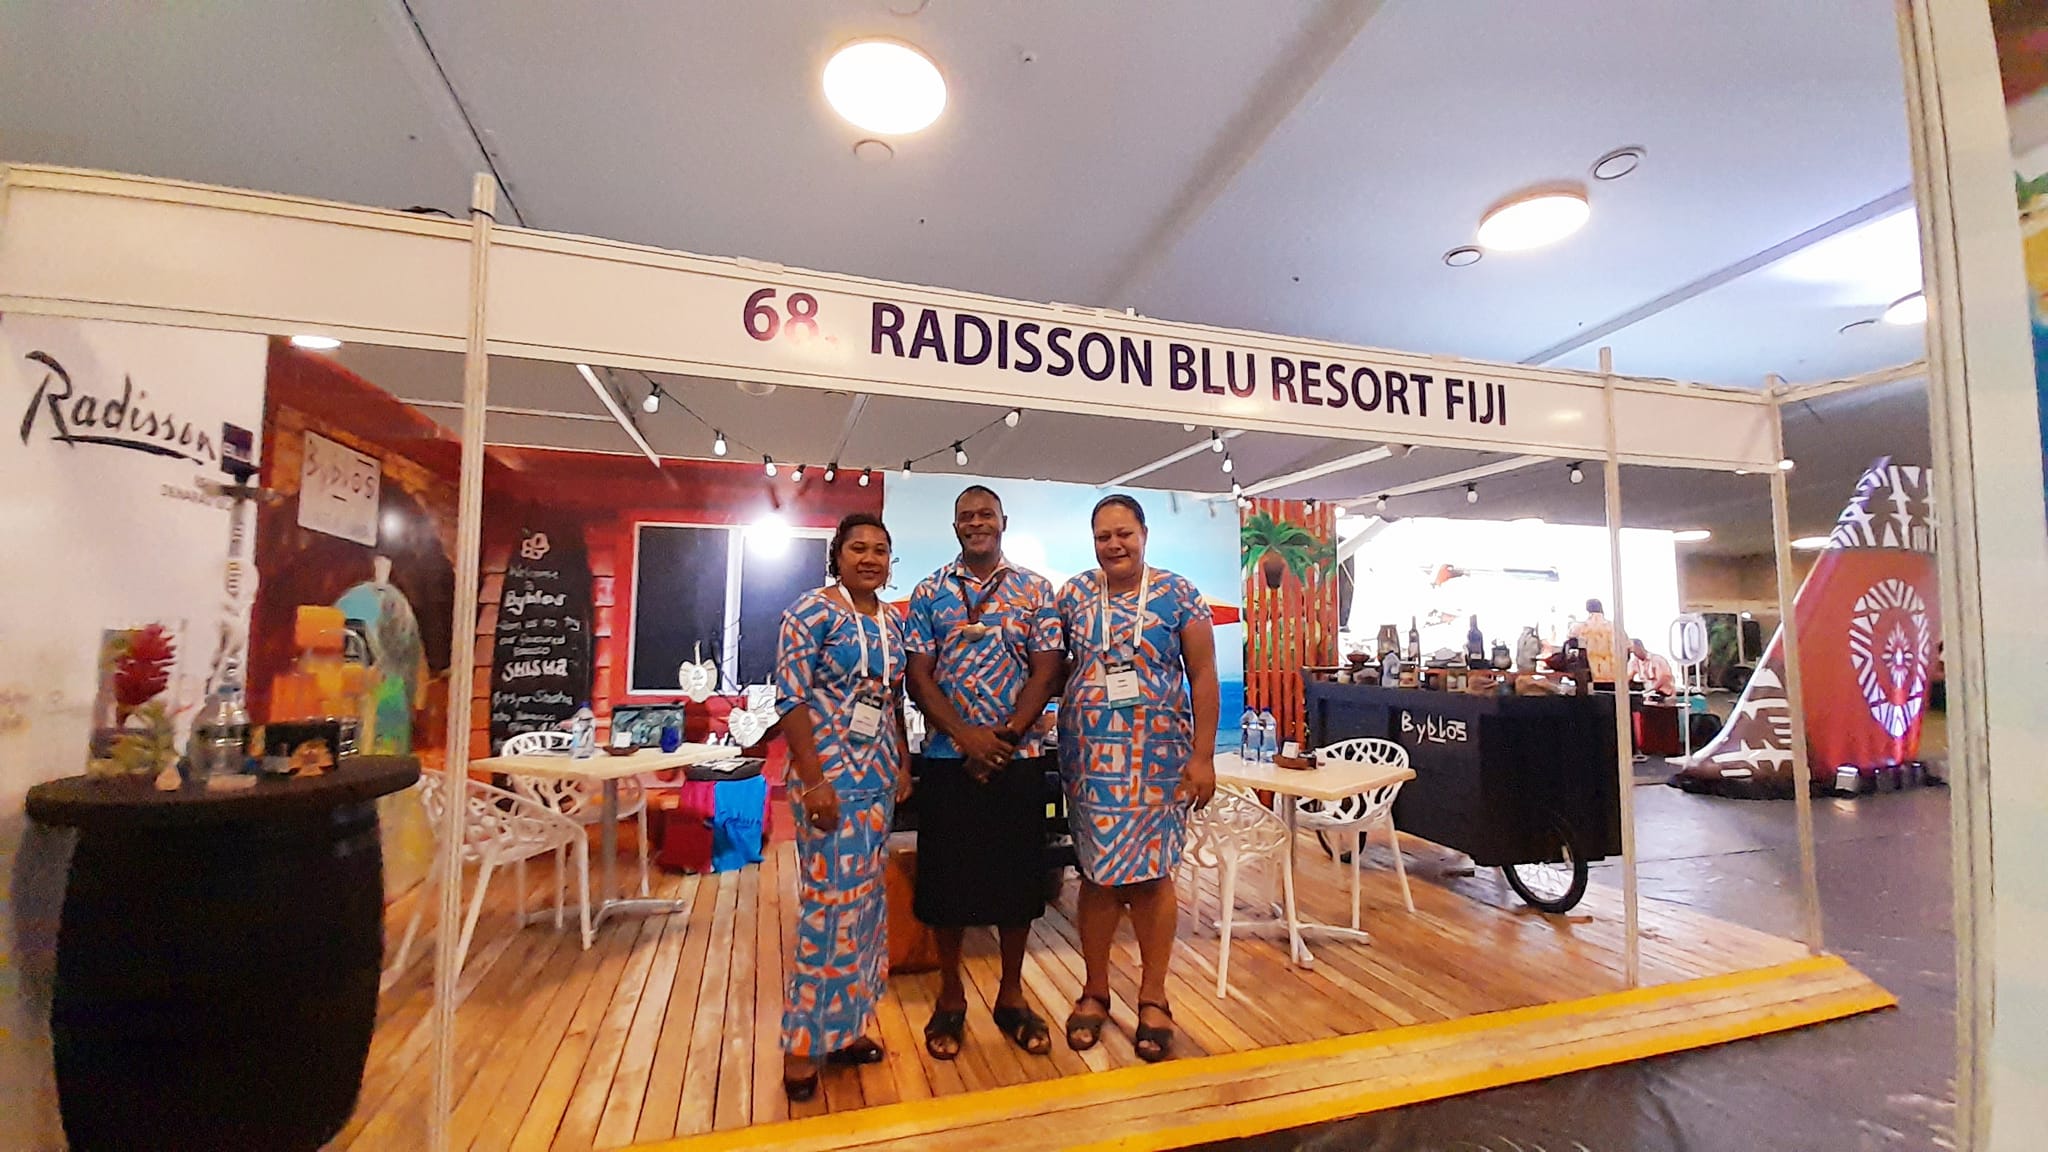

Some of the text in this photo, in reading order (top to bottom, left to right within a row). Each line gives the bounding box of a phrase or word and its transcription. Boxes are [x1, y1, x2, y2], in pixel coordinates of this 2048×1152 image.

[19, 350, 216, 462] Radisson
[871, 301, 1152, 387] RADISSON
[1169, 343, 1256, 398] BLU
[1270, 357, 1433, 417] RESORT
[1445, 378, 1507, 426] FIJI
[1401, 710, 1468, 744] Byblos
